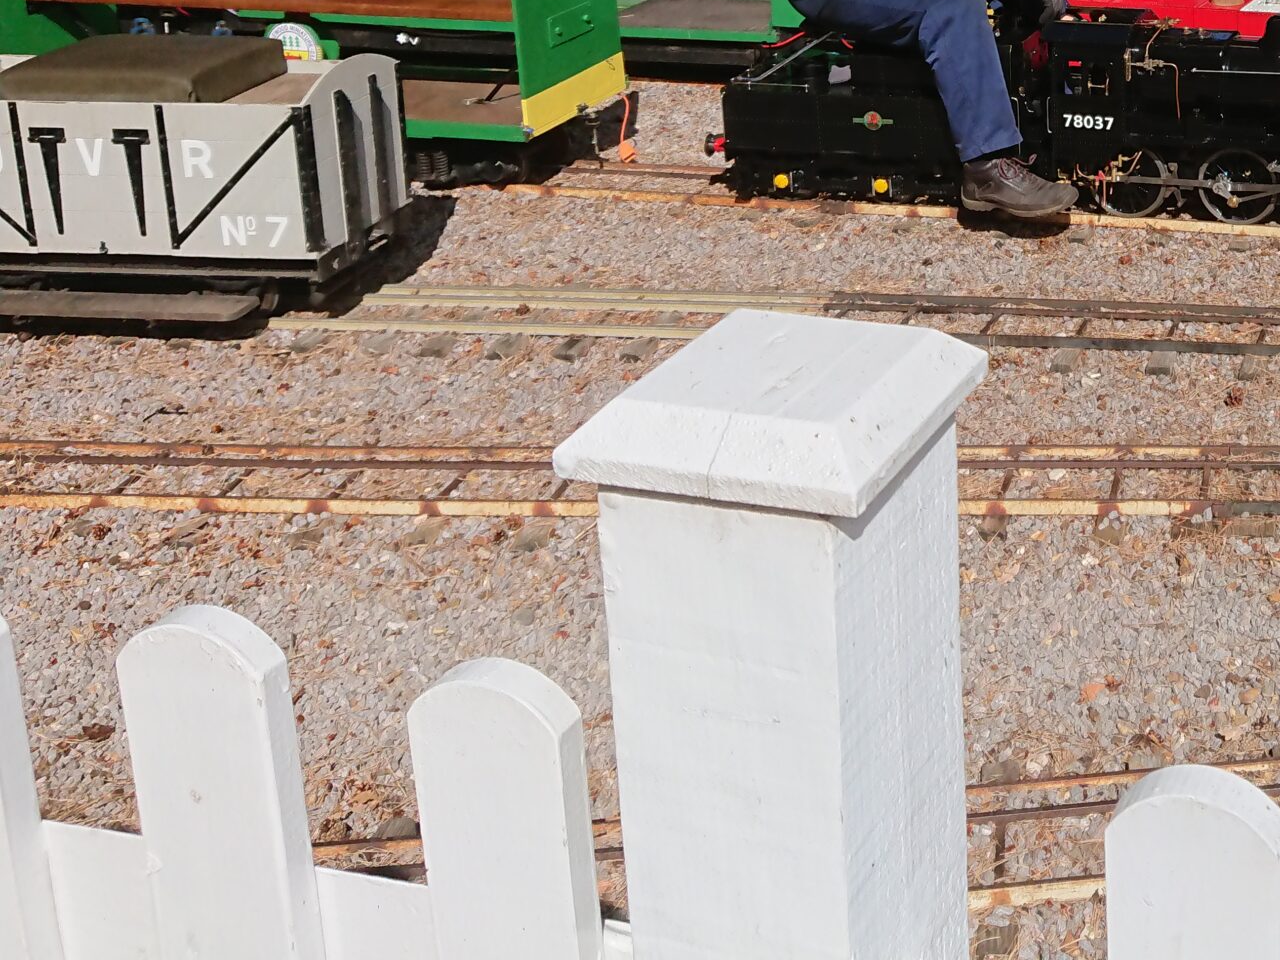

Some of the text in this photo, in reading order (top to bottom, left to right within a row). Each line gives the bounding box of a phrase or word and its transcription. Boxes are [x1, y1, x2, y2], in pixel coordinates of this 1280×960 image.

[1062, 113, 1115, 131] 78037
[75, 138, 214, 179] V R
[265, 216, 289, 248] 7
